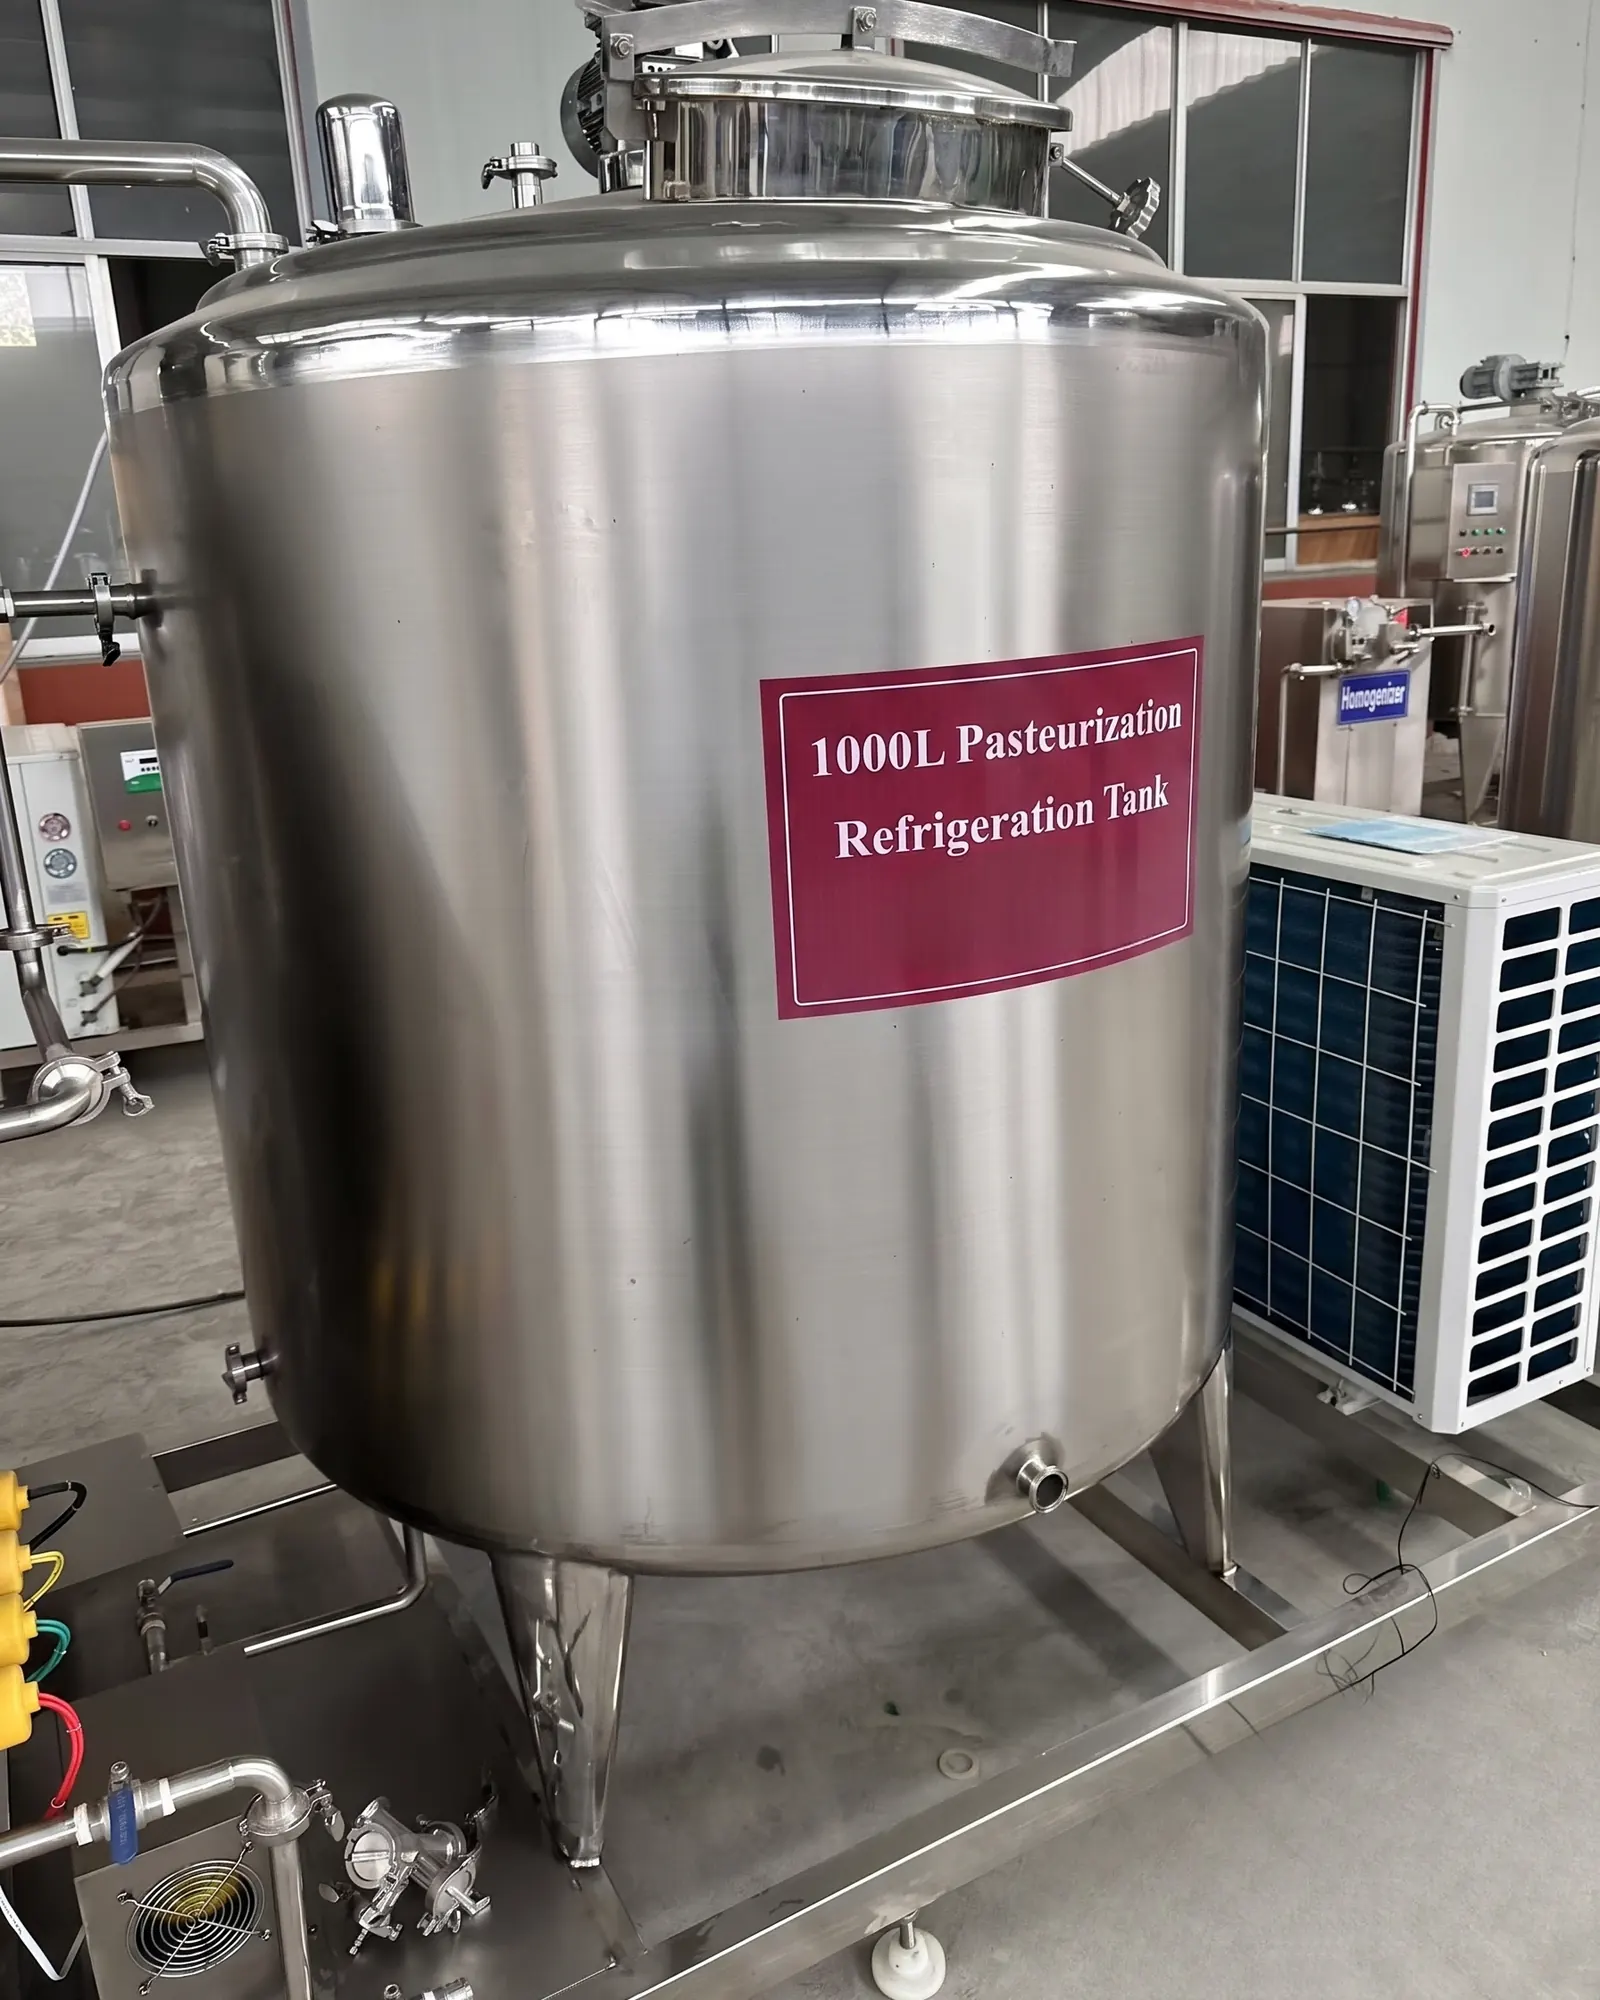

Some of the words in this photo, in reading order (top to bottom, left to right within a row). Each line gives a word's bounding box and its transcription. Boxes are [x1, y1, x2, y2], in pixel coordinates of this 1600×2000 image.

[1341, 681, 1406, 713] Homogenizer
[811, 729, 946, 777] 1000L
[956, 698, 1182, 764] Pasteurization
[834, 796, 1095, 858] Refrigeration
[1103, 773, 1169, 821] Tank
